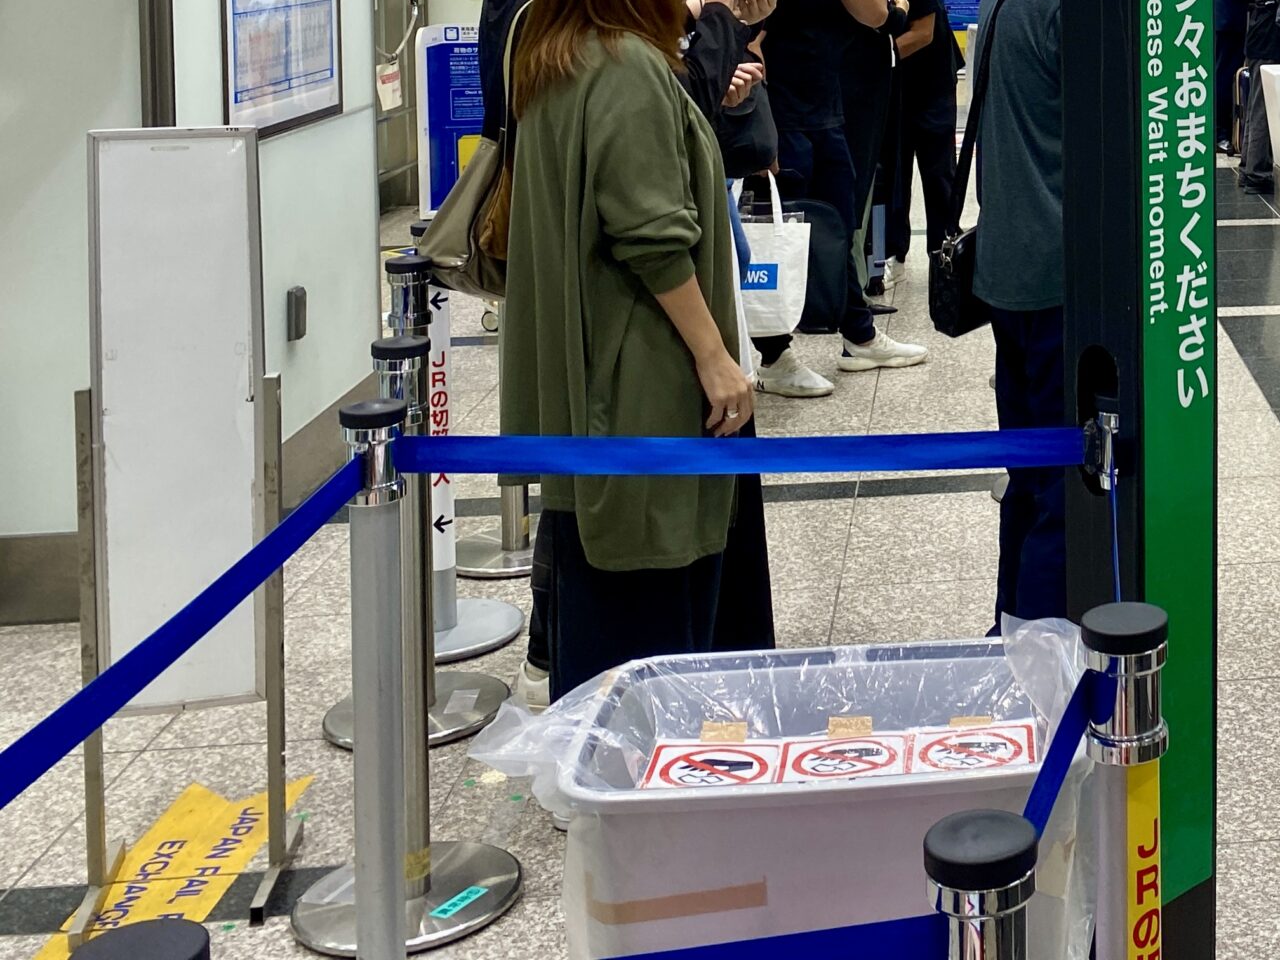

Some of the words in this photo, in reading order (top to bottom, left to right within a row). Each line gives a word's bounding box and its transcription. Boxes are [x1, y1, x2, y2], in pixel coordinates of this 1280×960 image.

[1148, 87, 1169, 164] Wait
[745, 270, 769, 284] WS
[1149, 173, 1168, 325] moment.
[204, 807, 264, 860] JAPAN
